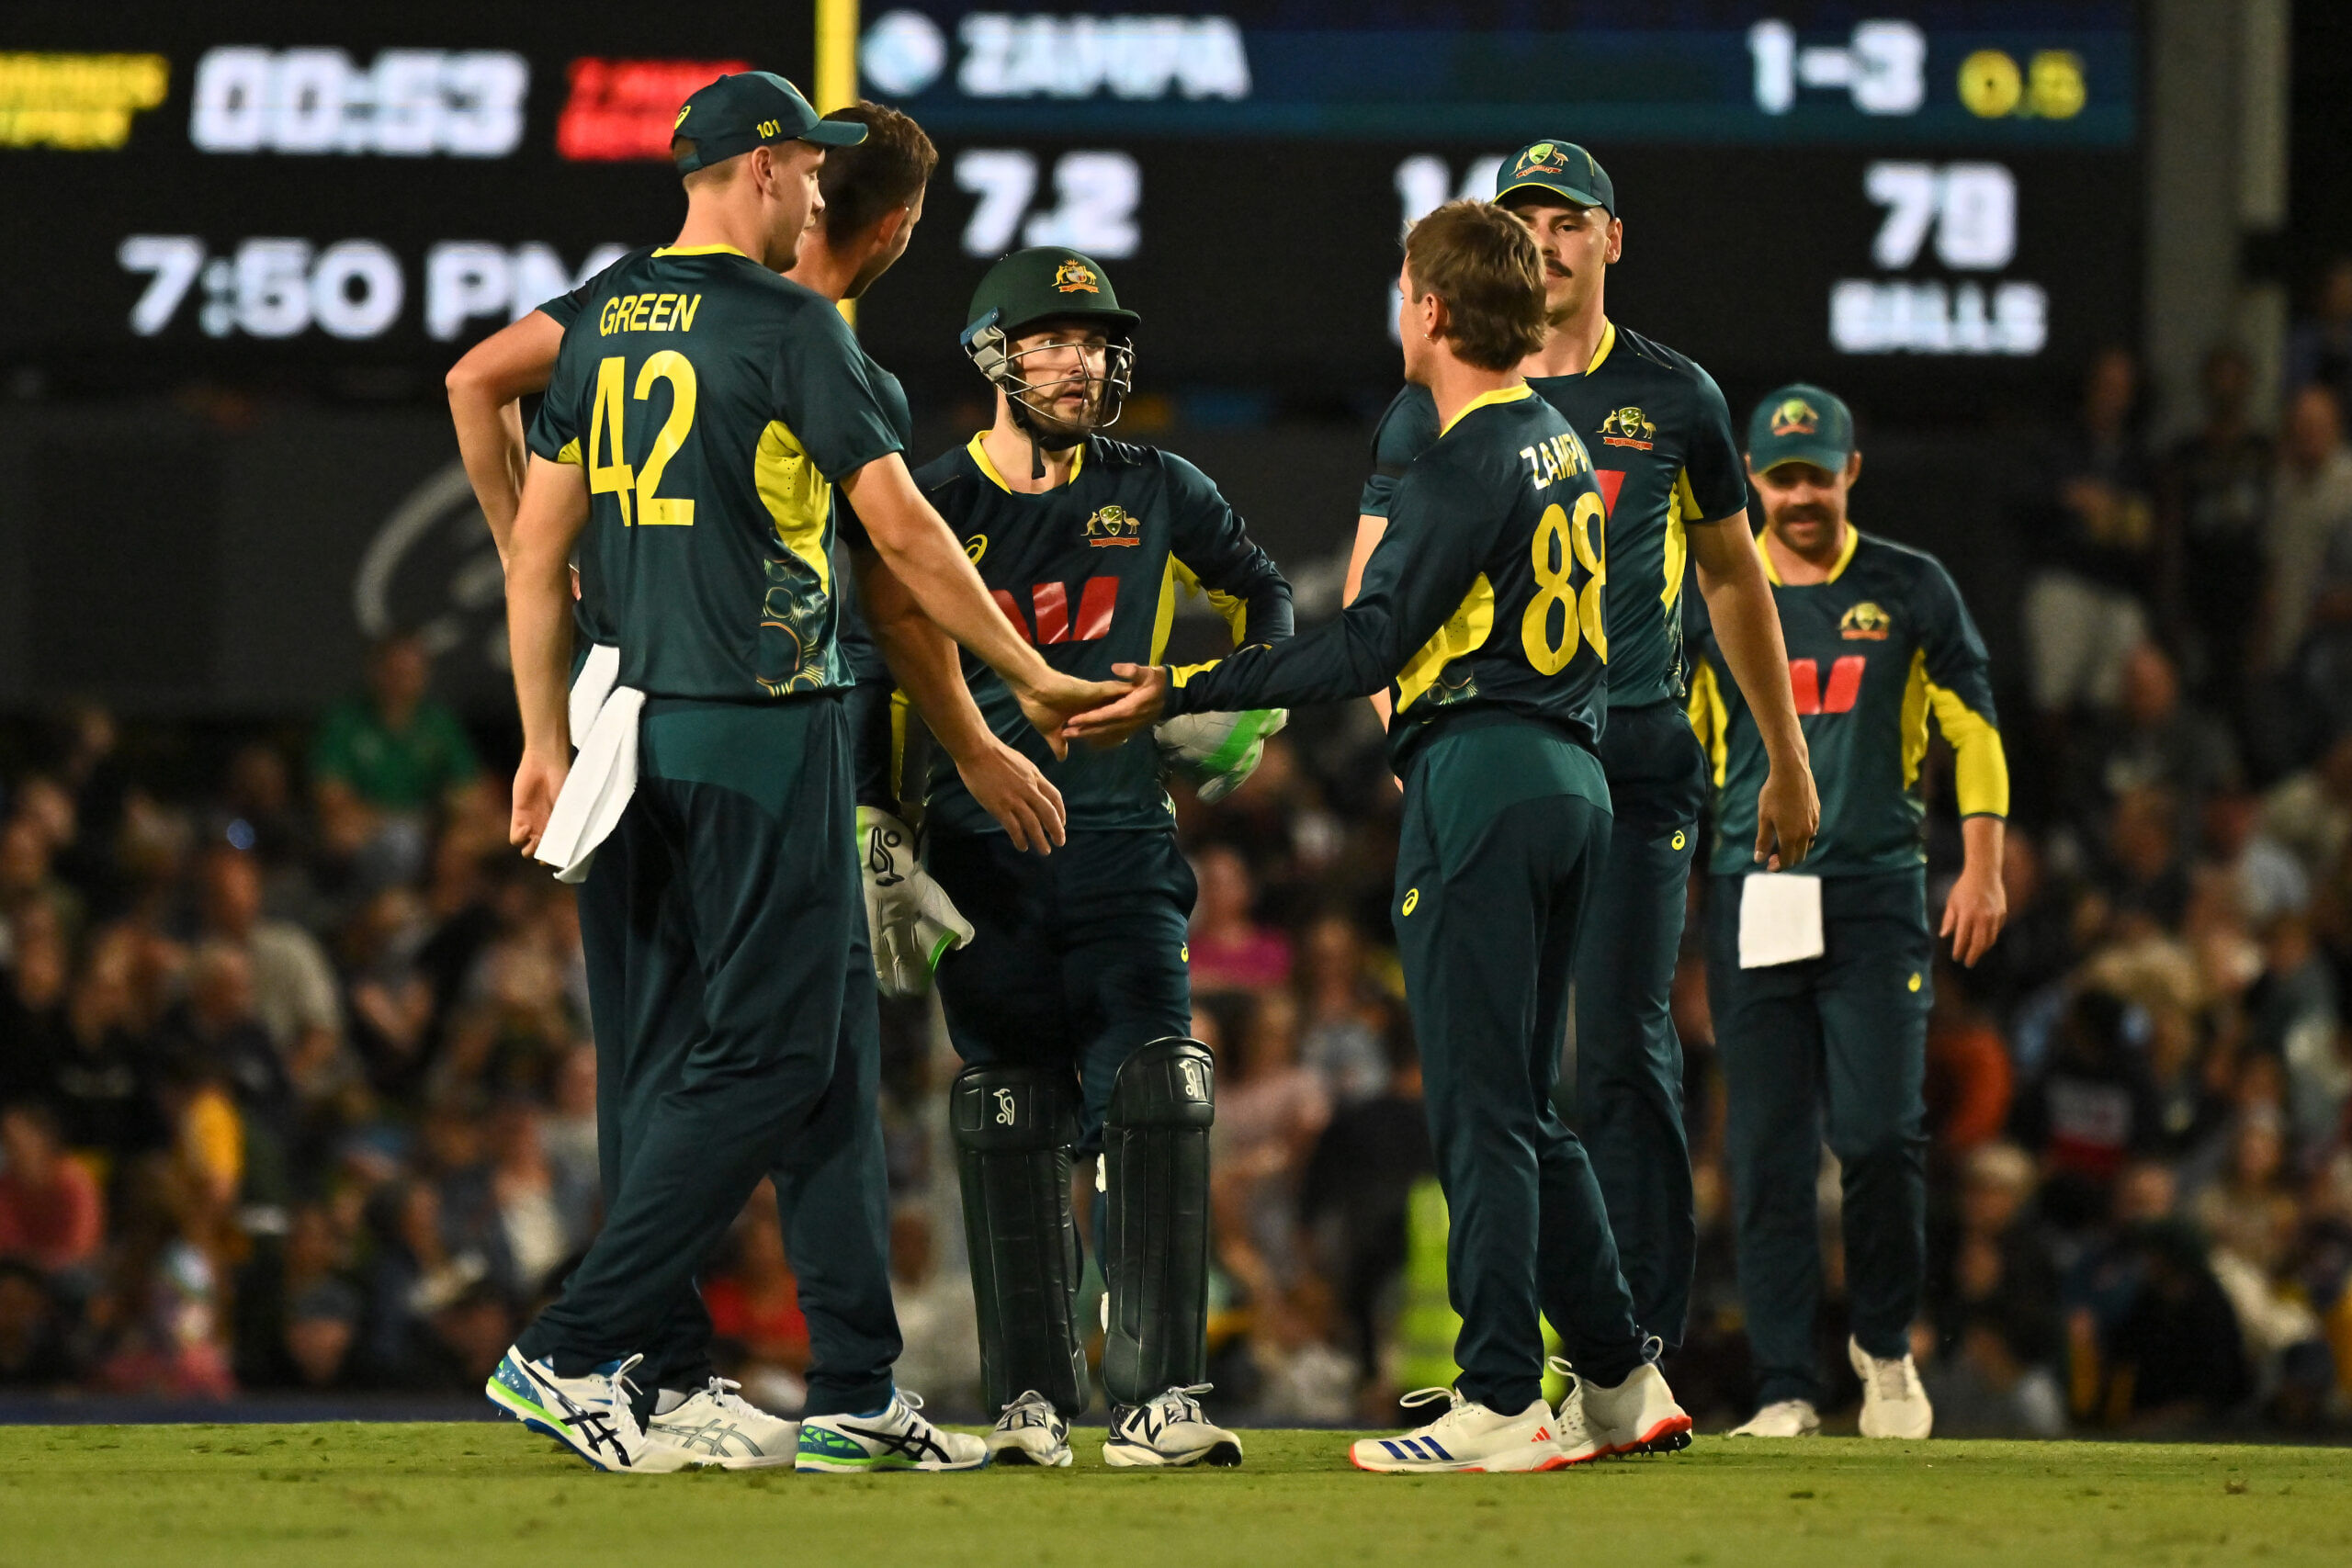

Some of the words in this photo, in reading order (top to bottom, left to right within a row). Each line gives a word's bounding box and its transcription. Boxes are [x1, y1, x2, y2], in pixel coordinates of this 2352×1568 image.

[191, 46, 531, 157] 00:53
[957, 15, 1251, 99] ZAMPA
[1750, 19, 1926, 115] 1-3
[756, 119, 782, 139] 101
[956, 151, 1140, 257] 7.2
[120, 235, 405, 339] 7:50
[599, 293, 702, 337] GREEN
[1830, 280, 2049, 355] BALLS
[589, 350, 697, 527] 42
[1521, 491, 1608, 676] 88
